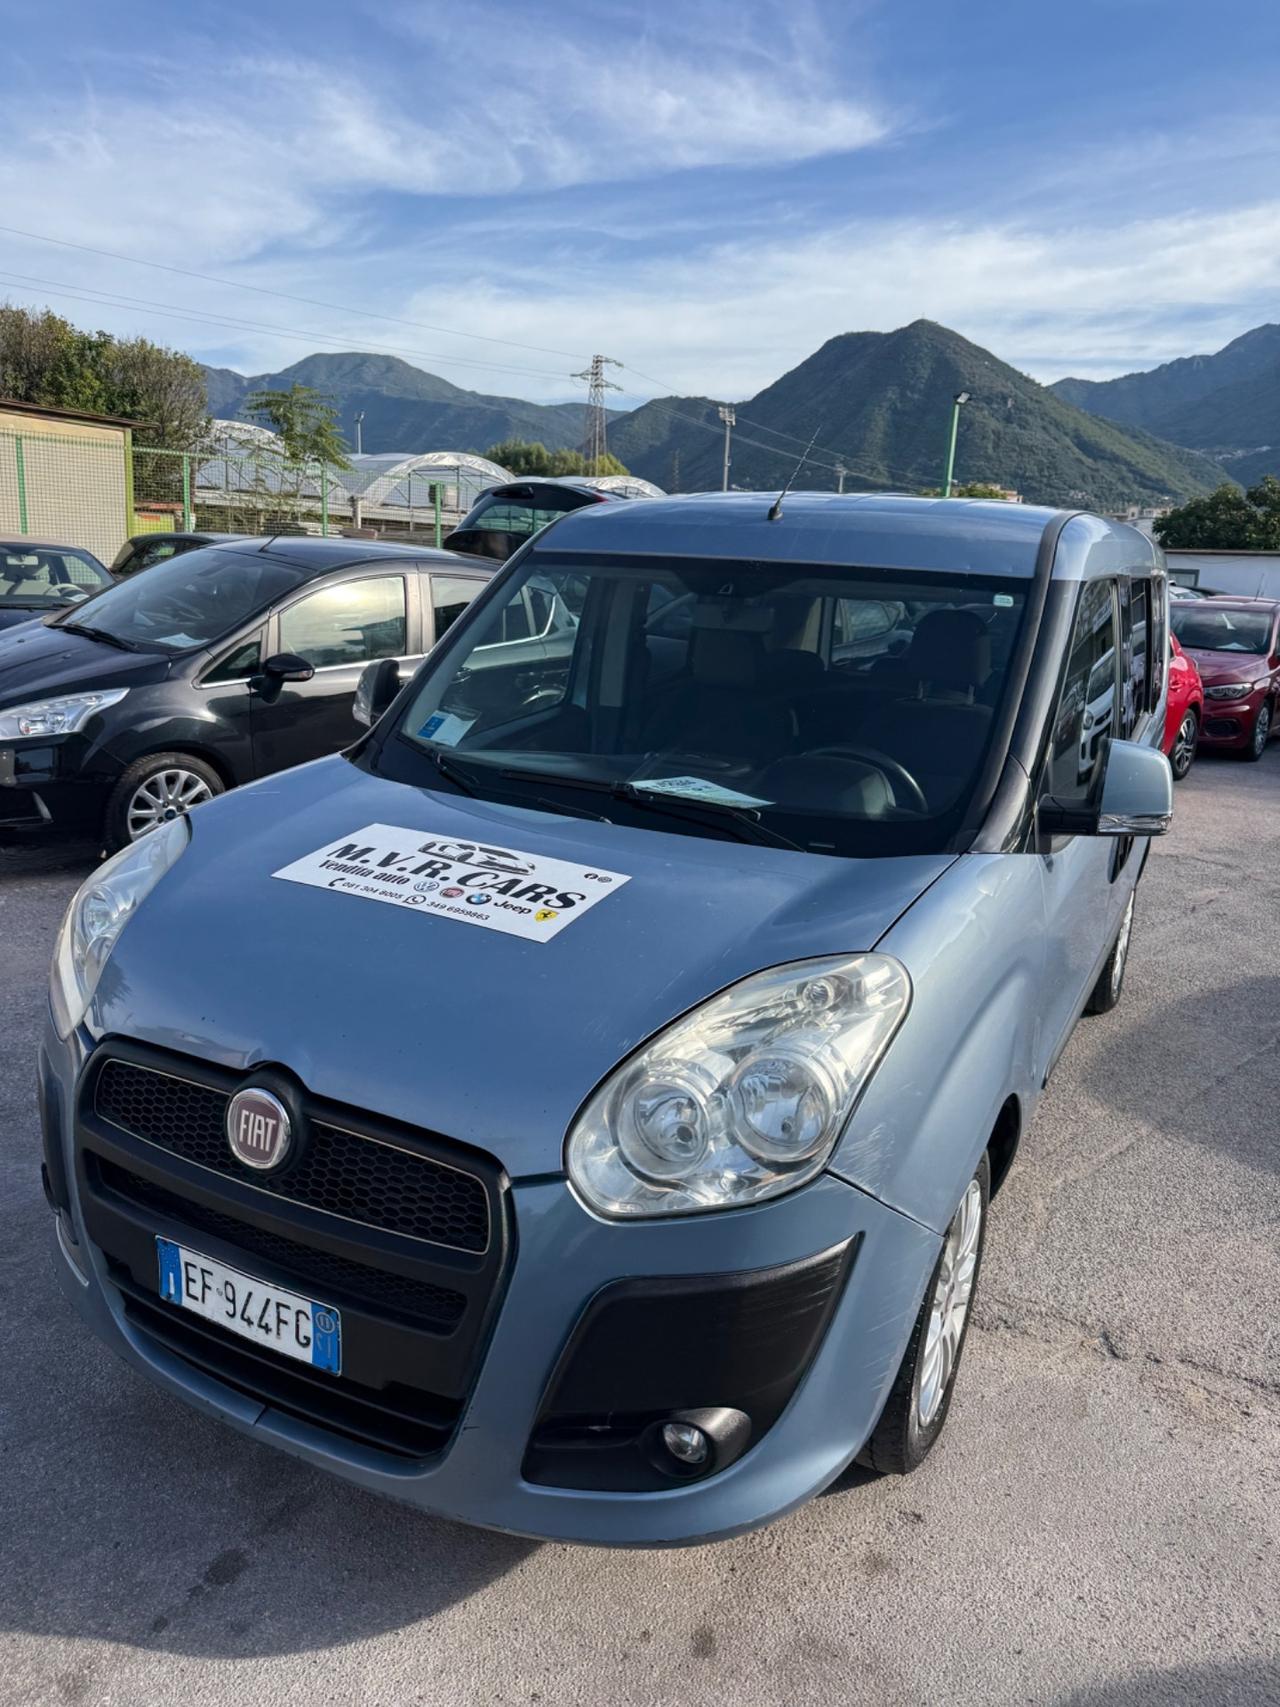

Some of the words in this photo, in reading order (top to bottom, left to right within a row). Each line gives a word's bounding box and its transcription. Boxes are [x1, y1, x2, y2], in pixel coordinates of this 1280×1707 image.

[319, 859, 376, 877] Vendita
[372, 872, 411, 885] auto
[342, 881, 360, 890] 081
[360, 886, 380, 894] 304
[379, 890, 405, 899] 8005
[427, 901, 447, 910] 349
[493, 900, 533, 915] Jeep
[240, 1109, 276, 1152] FIAT
